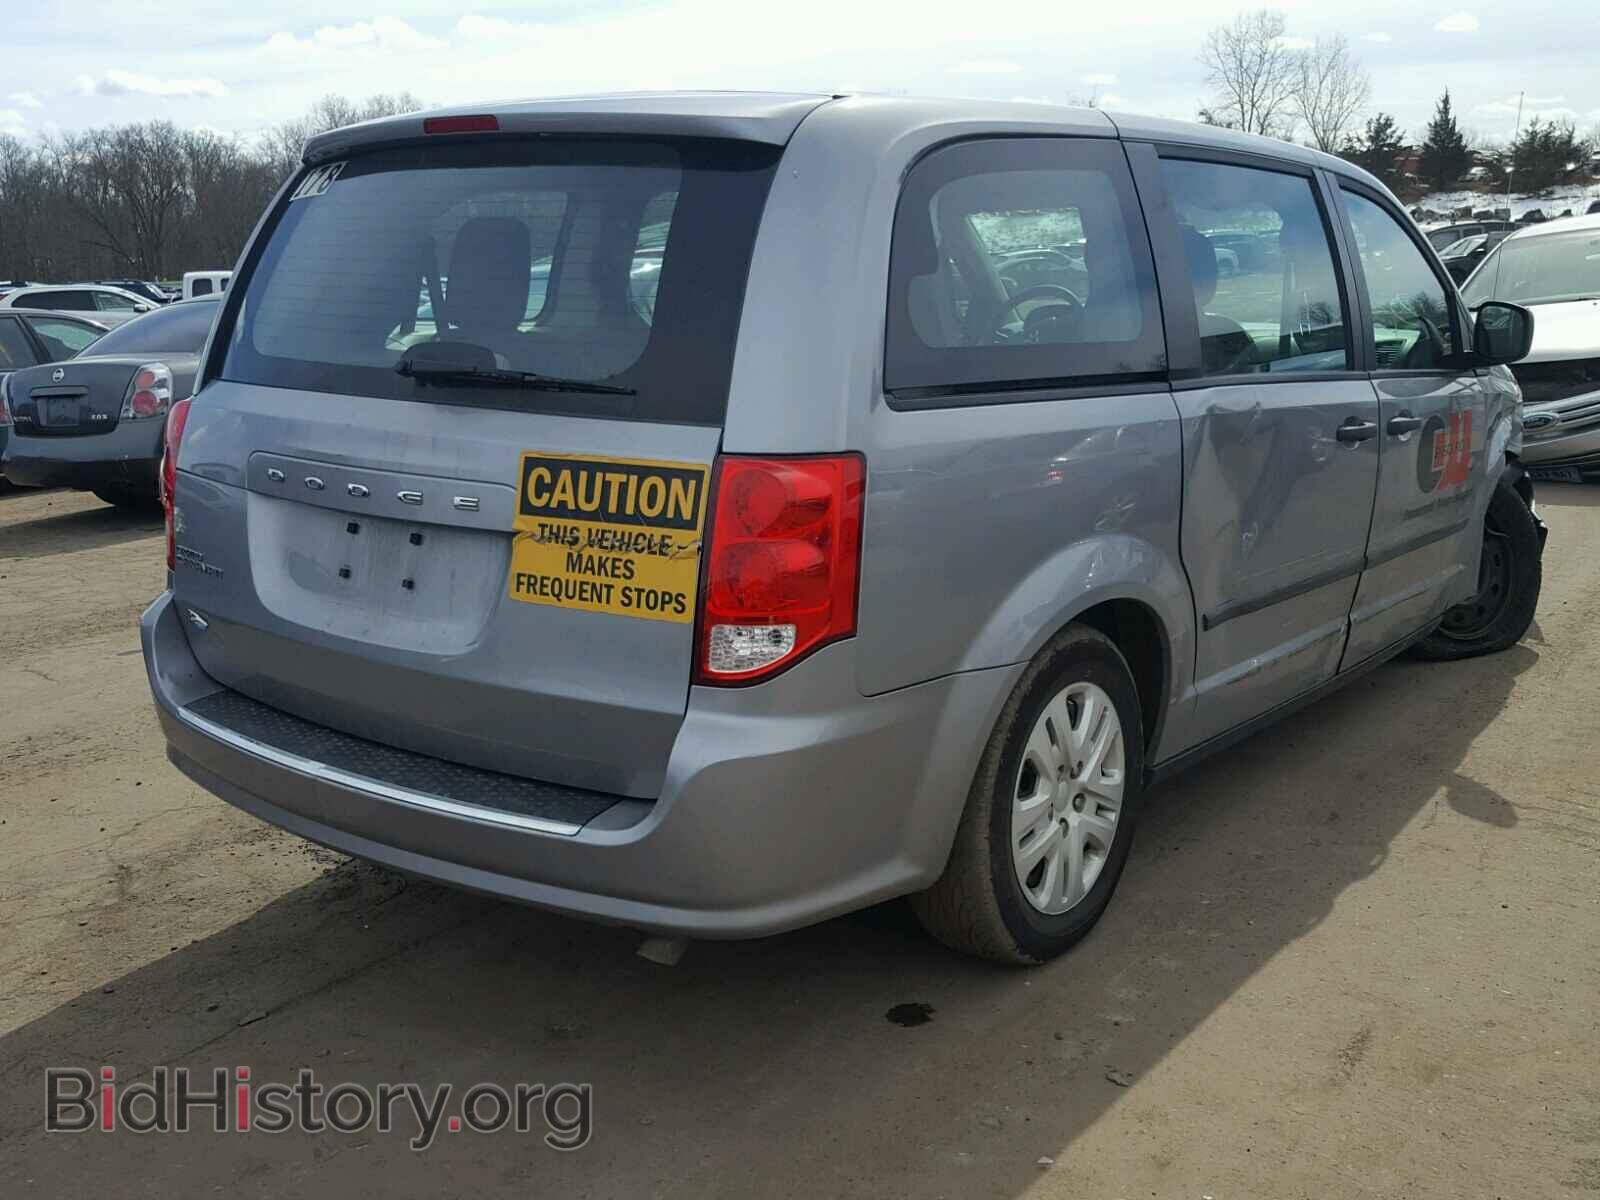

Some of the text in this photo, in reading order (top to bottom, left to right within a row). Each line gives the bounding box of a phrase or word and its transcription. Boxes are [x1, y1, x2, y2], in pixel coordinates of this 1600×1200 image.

[268, 468, 480, 511] DODGE
[527, 467, 697, 521] CAUTION
[537, 523, 674, 558] THIS VEHICLE
[565, 552, 636, 581] MAKES
[515, 572, 687, 614] FREQUENT STOPS
